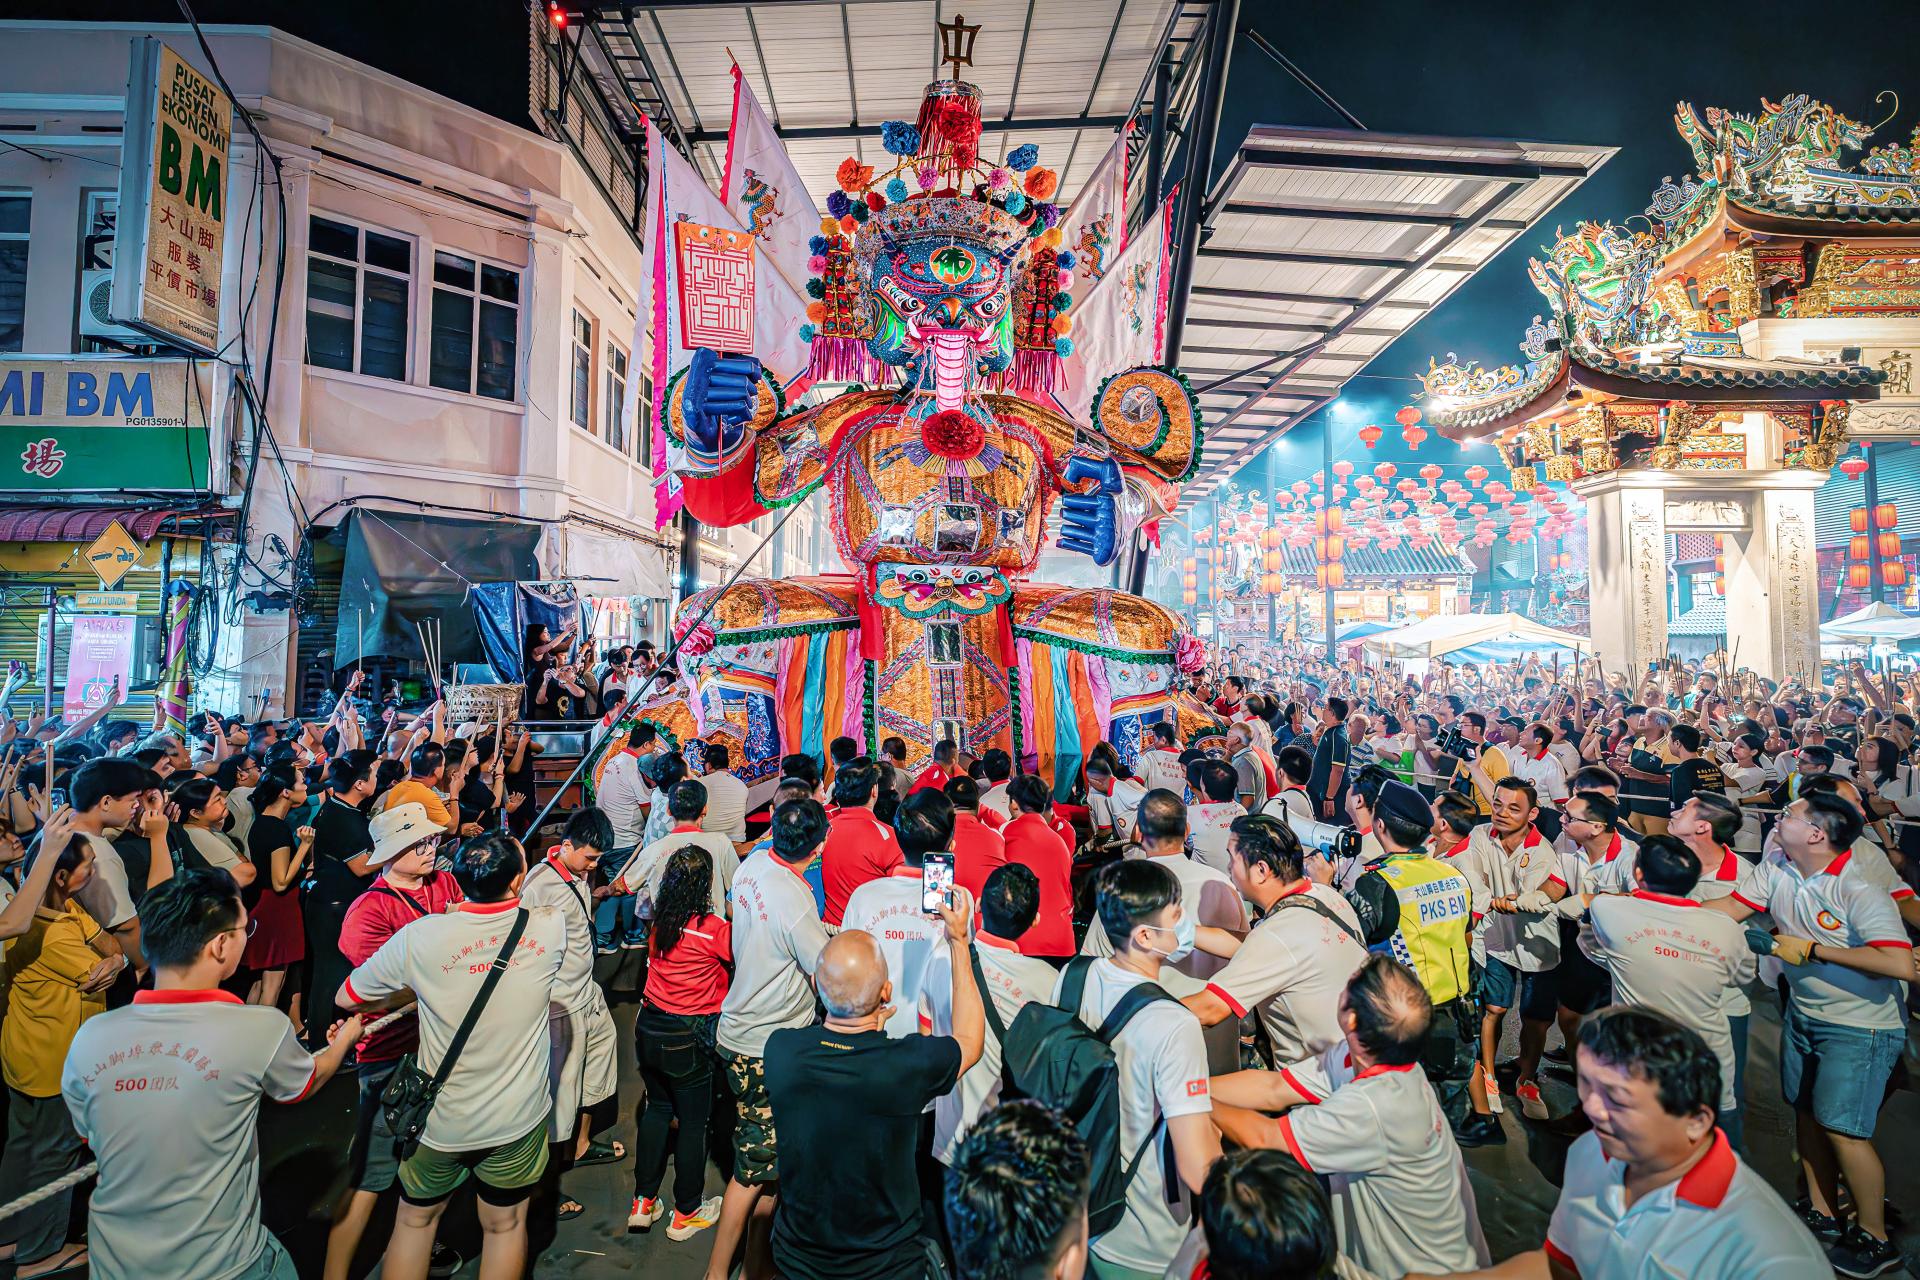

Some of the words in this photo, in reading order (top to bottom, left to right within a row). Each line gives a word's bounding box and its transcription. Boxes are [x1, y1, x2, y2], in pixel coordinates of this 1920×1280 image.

[172, 80, 218, 129] FESYEN
[175, 63, 216, 107] PUSAT
[162, 92, 225, 153] EKONOMI
[159, 121, 221, 222] BM
[160, 205, 214, 252] 大山脚
[167, 240, 201, 273] 服裝
[150, 260, 217, 308] 平價市場
[66, 372, 154, 417] BM
[126, 417, 188, 427] PG0135901-V
[22, 438, 66, 478] 場
[1420, 899, 1447, 921] PKS
[885, 930, 905, 941] 500
[1654, 945, 1679, 959] 500
[469, 961, 493, 975] 500
[114, 1078, 147, 1092] 500
